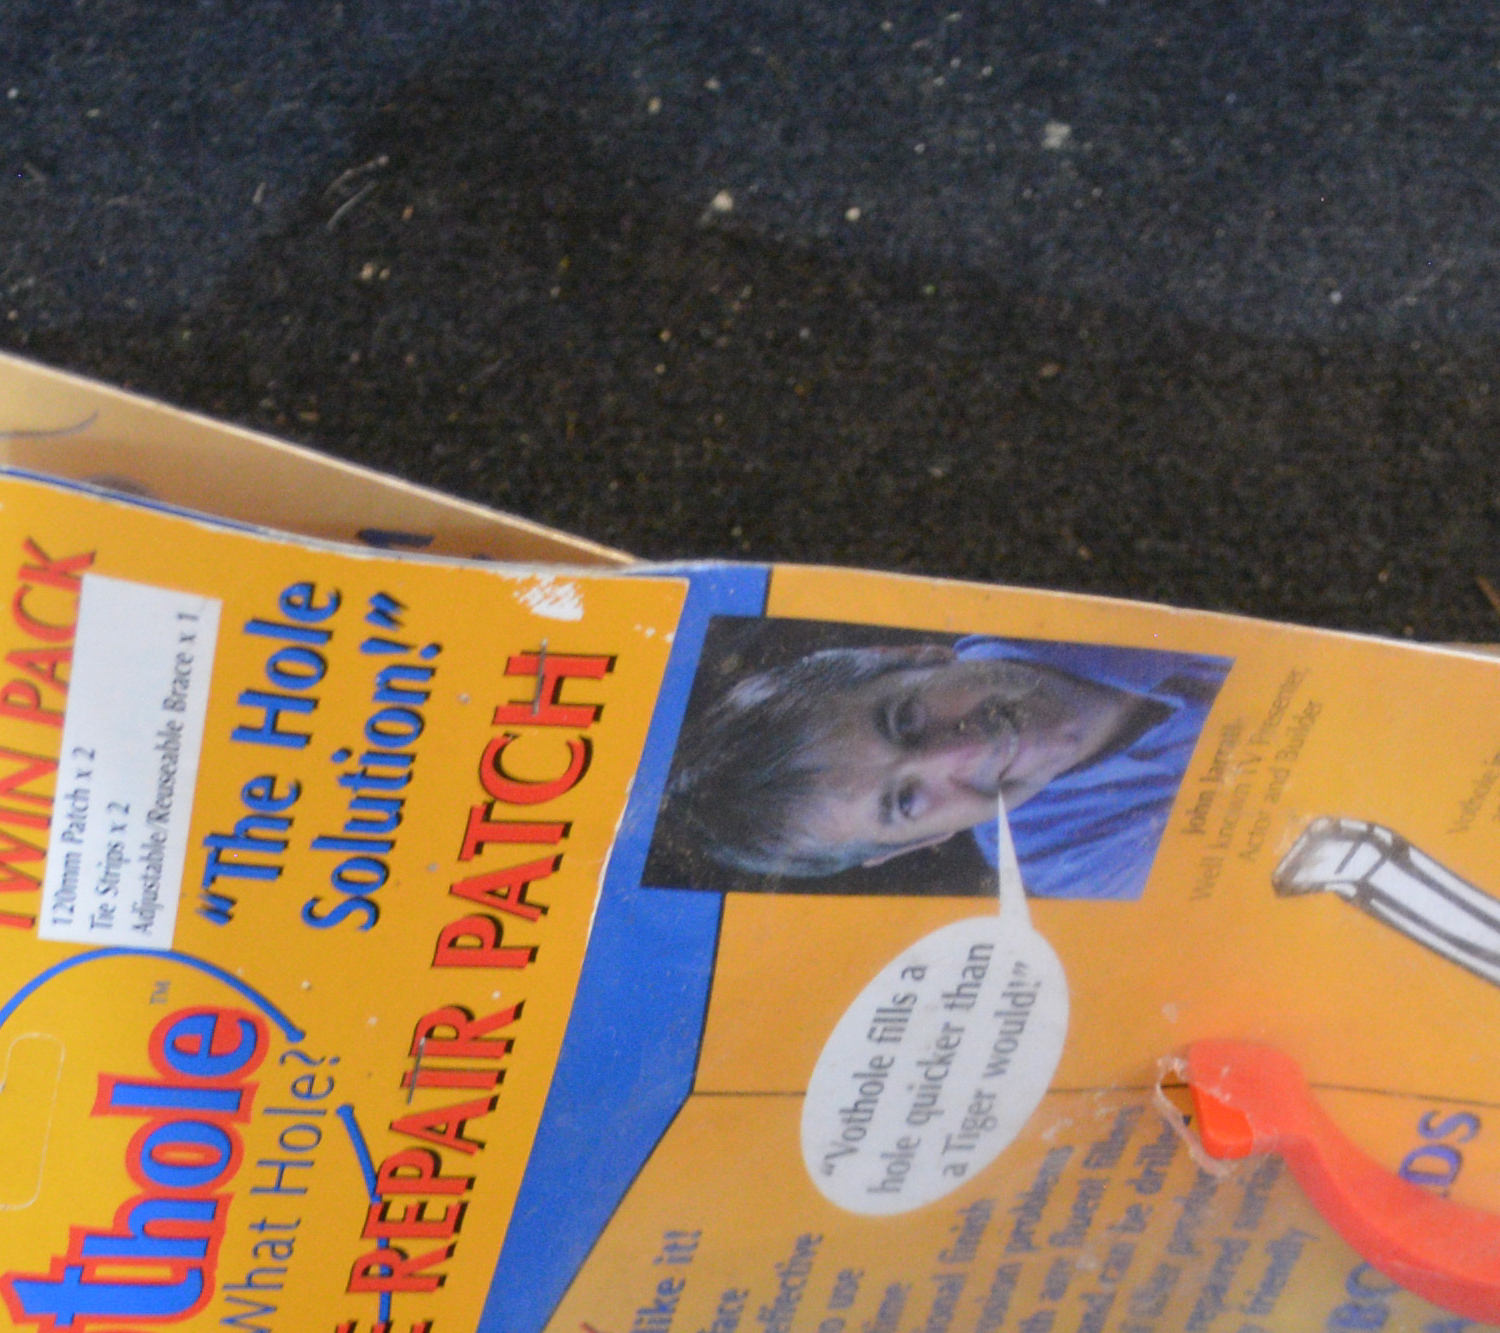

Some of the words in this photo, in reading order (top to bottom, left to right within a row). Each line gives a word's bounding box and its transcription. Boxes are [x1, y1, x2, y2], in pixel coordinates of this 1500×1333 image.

[230, 580, 343, 750] Hole
[73, 745, 97, 763] 2
[76, 766, 92, 782] x
[130, 717, 186, 937] Adjustable/Reuseable
[162, 652, 194, 714] Brace
[180, 631, 197, 646] x
[62, 783, 91, 852] Patch
[108, 800, 133, 817] 2
[113, 820, 129, 834] x
[431, 647, 619, 970] PATCH
[1181, 776, 1219, 836] John
[52, 856, 89, 928] 120mm
[106, 833, 132, 900] Strips
[90, 900, 115, 934] Tie
[865, 991, 919, 1046] fills
[901, 963, 930, 982] a
[866, 1134, 922, 1195] hole
[904, 1020, 967, 1127] quicker
[940, 942, 996, 1013] than
[250, 1048, 342, 1196] Hole?
[345, 1000, 527, 1294] REPAIR
[940, 1087, 999, 1157] Tiger
[942, 1161, 969, 1179] a
[654, 1229, 702, 1266] it!
